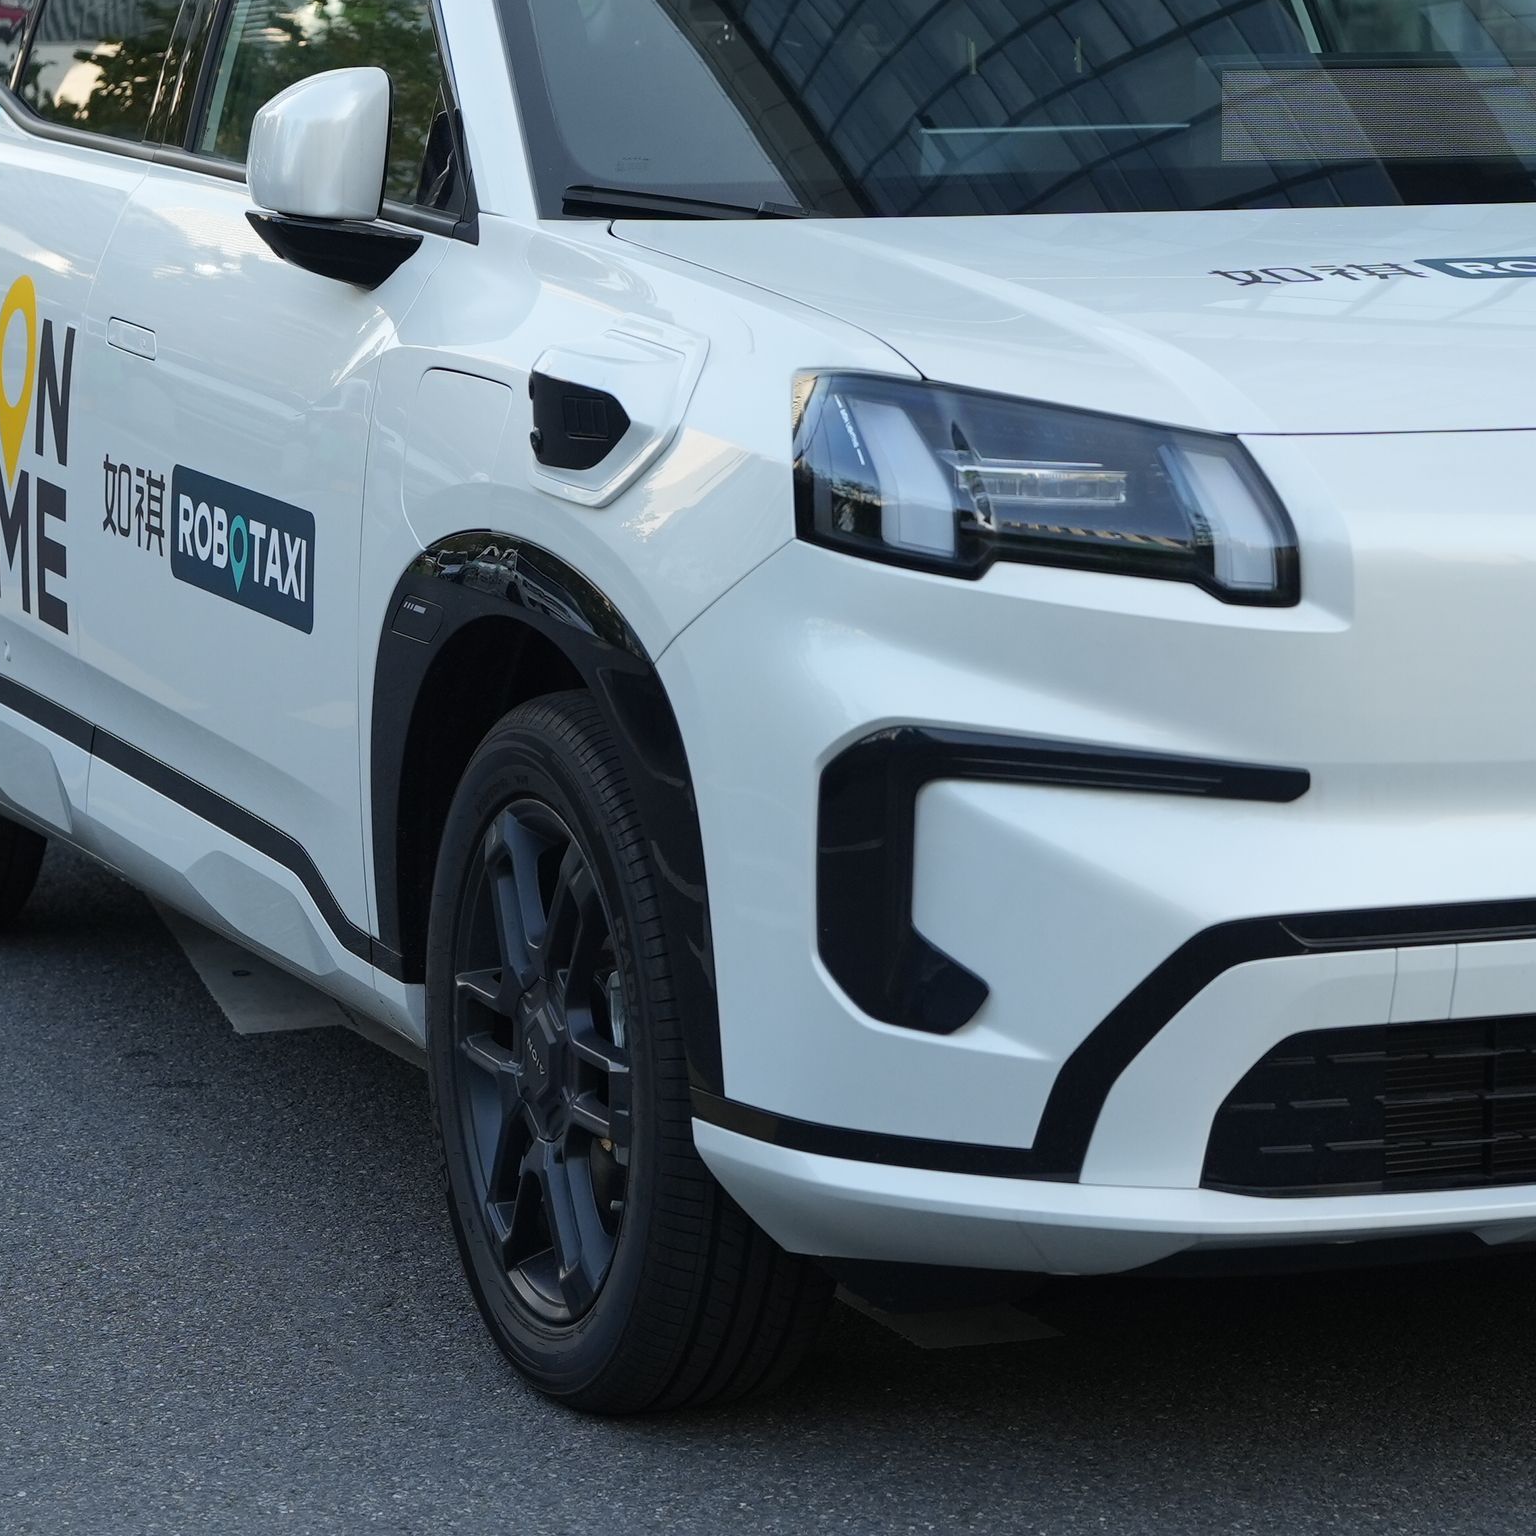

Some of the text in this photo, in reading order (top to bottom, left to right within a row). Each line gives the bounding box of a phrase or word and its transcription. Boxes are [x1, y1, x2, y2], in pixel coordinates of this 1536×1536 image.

[1208, 261, 1431, 287] 如祺
[103, 453, 307, 603] 如祺 ROBOTAXI
